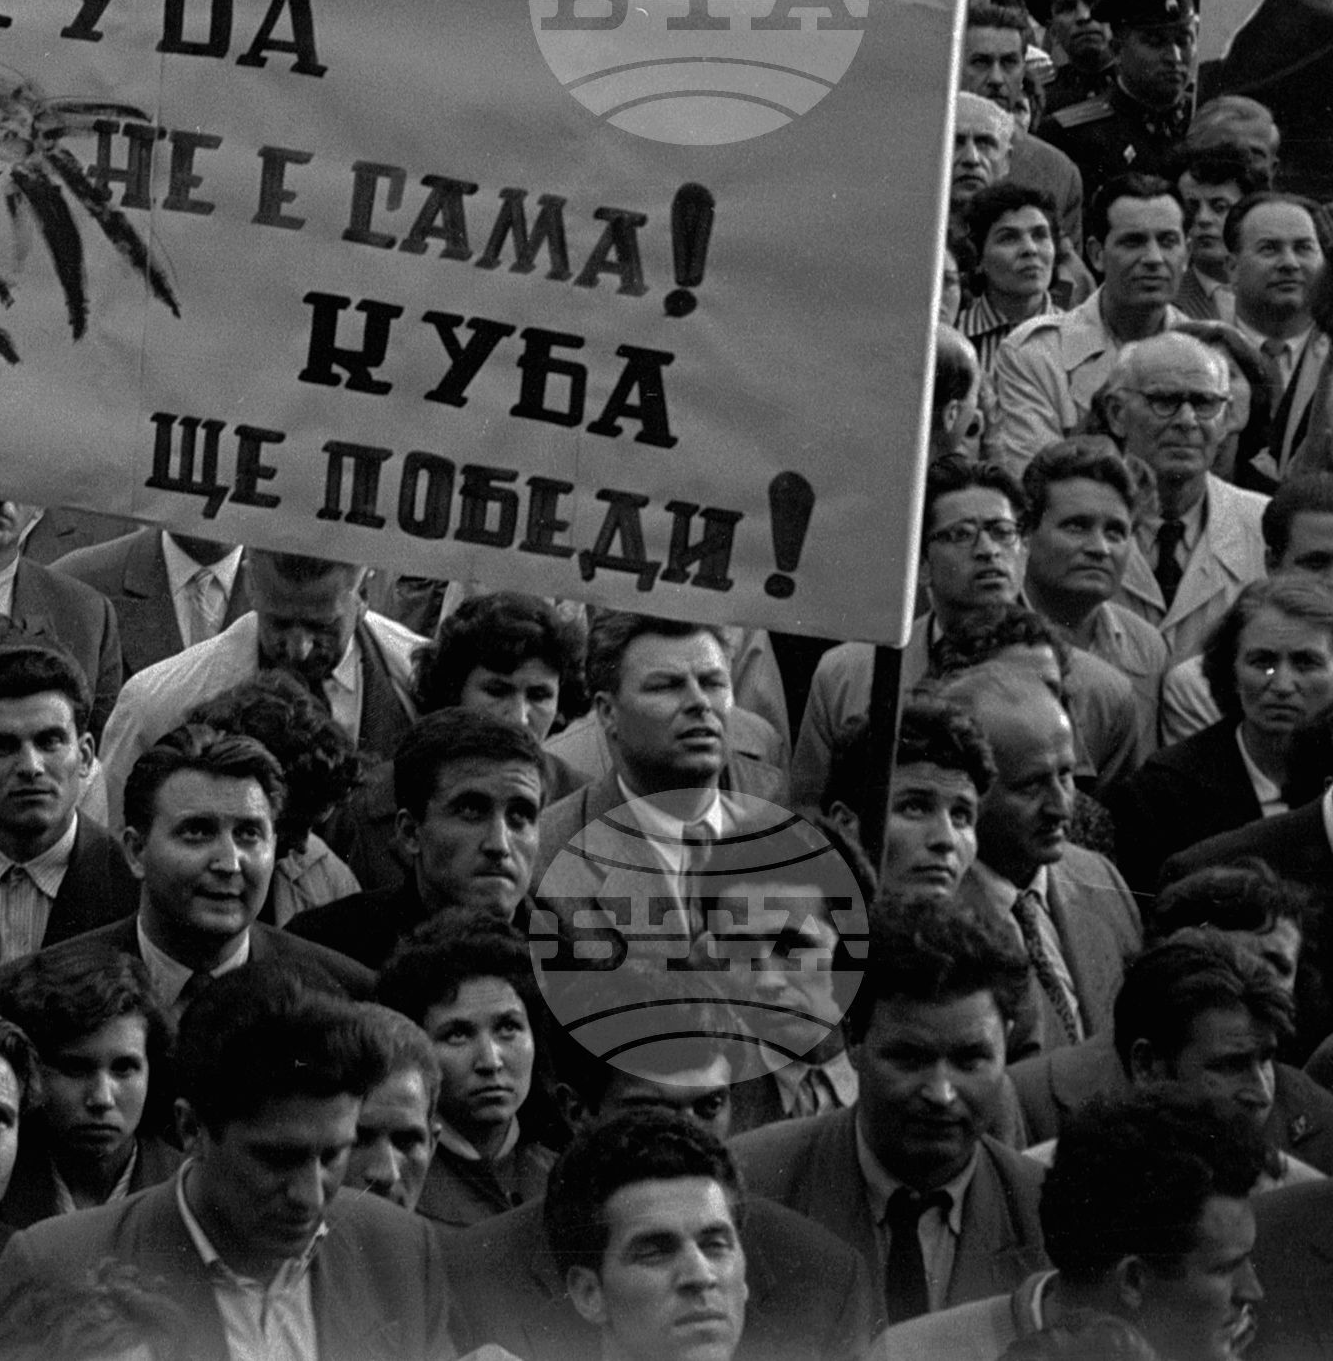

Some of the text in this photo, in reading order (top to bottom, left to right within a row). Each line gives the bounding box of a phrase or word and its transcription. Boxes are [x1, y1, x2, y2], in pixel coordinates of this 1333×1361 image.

[87, 119, 717, 319] НЕ Е САМА!
[298, 291, 677, 449] КУБА
[143, 411, 816, 600] ЩЕ ПОБЕДИ!
